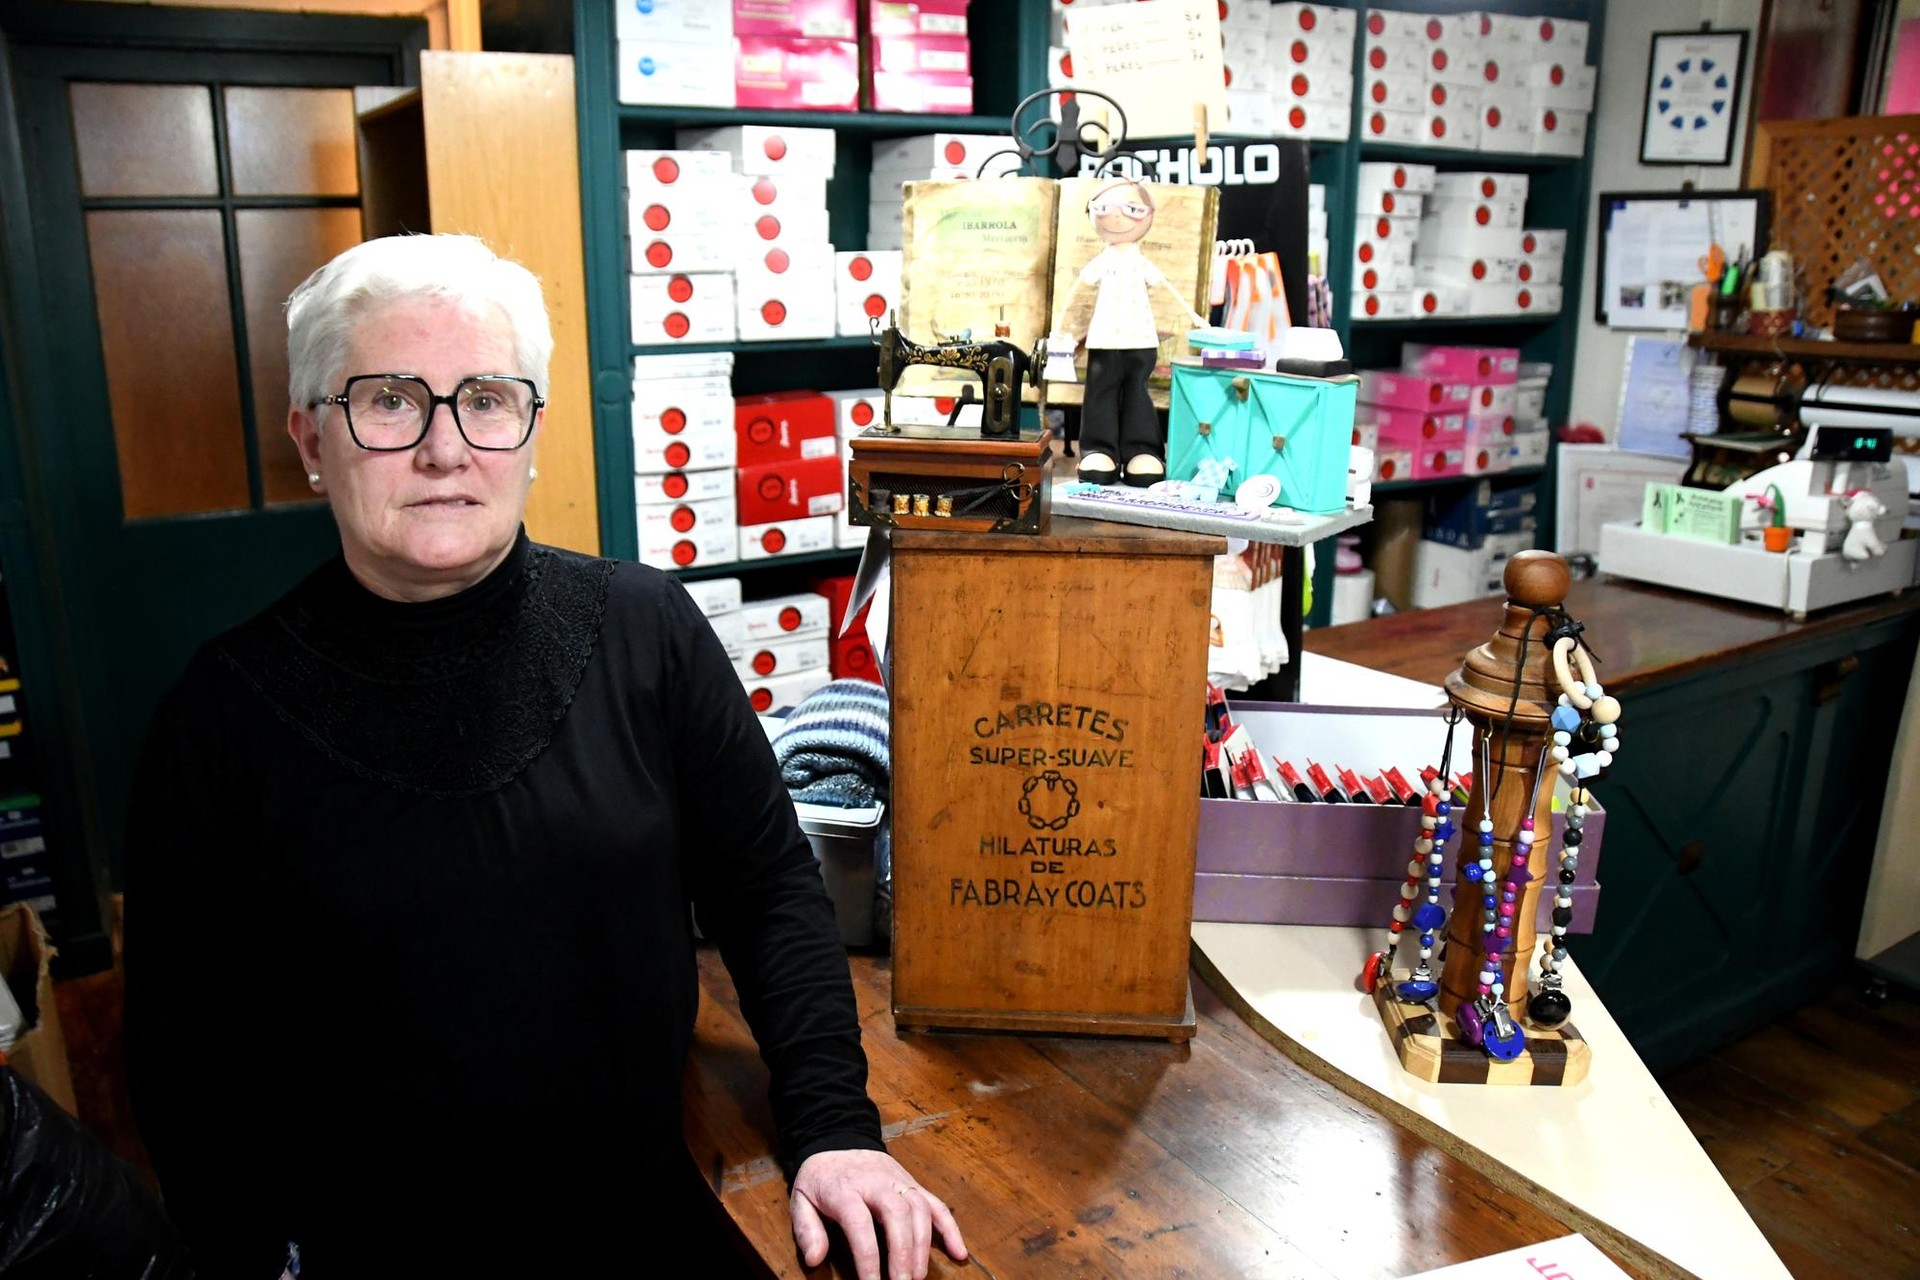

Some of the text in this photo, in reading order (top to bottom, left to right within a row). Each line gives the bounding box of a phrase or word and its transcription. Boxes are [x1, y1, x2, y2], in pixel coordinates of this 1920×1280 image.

[962, 221, 1018, 230] IBARROLA
[973, 702, 1129, 743] CARRETES
[970, 747, 1134, 768] SUPER-SUAVE
[979, 837, 1117, 857] HILATURAS
[1030, 861, 1065, 875] DE
[1065, 881, 1146, 909] COATS
